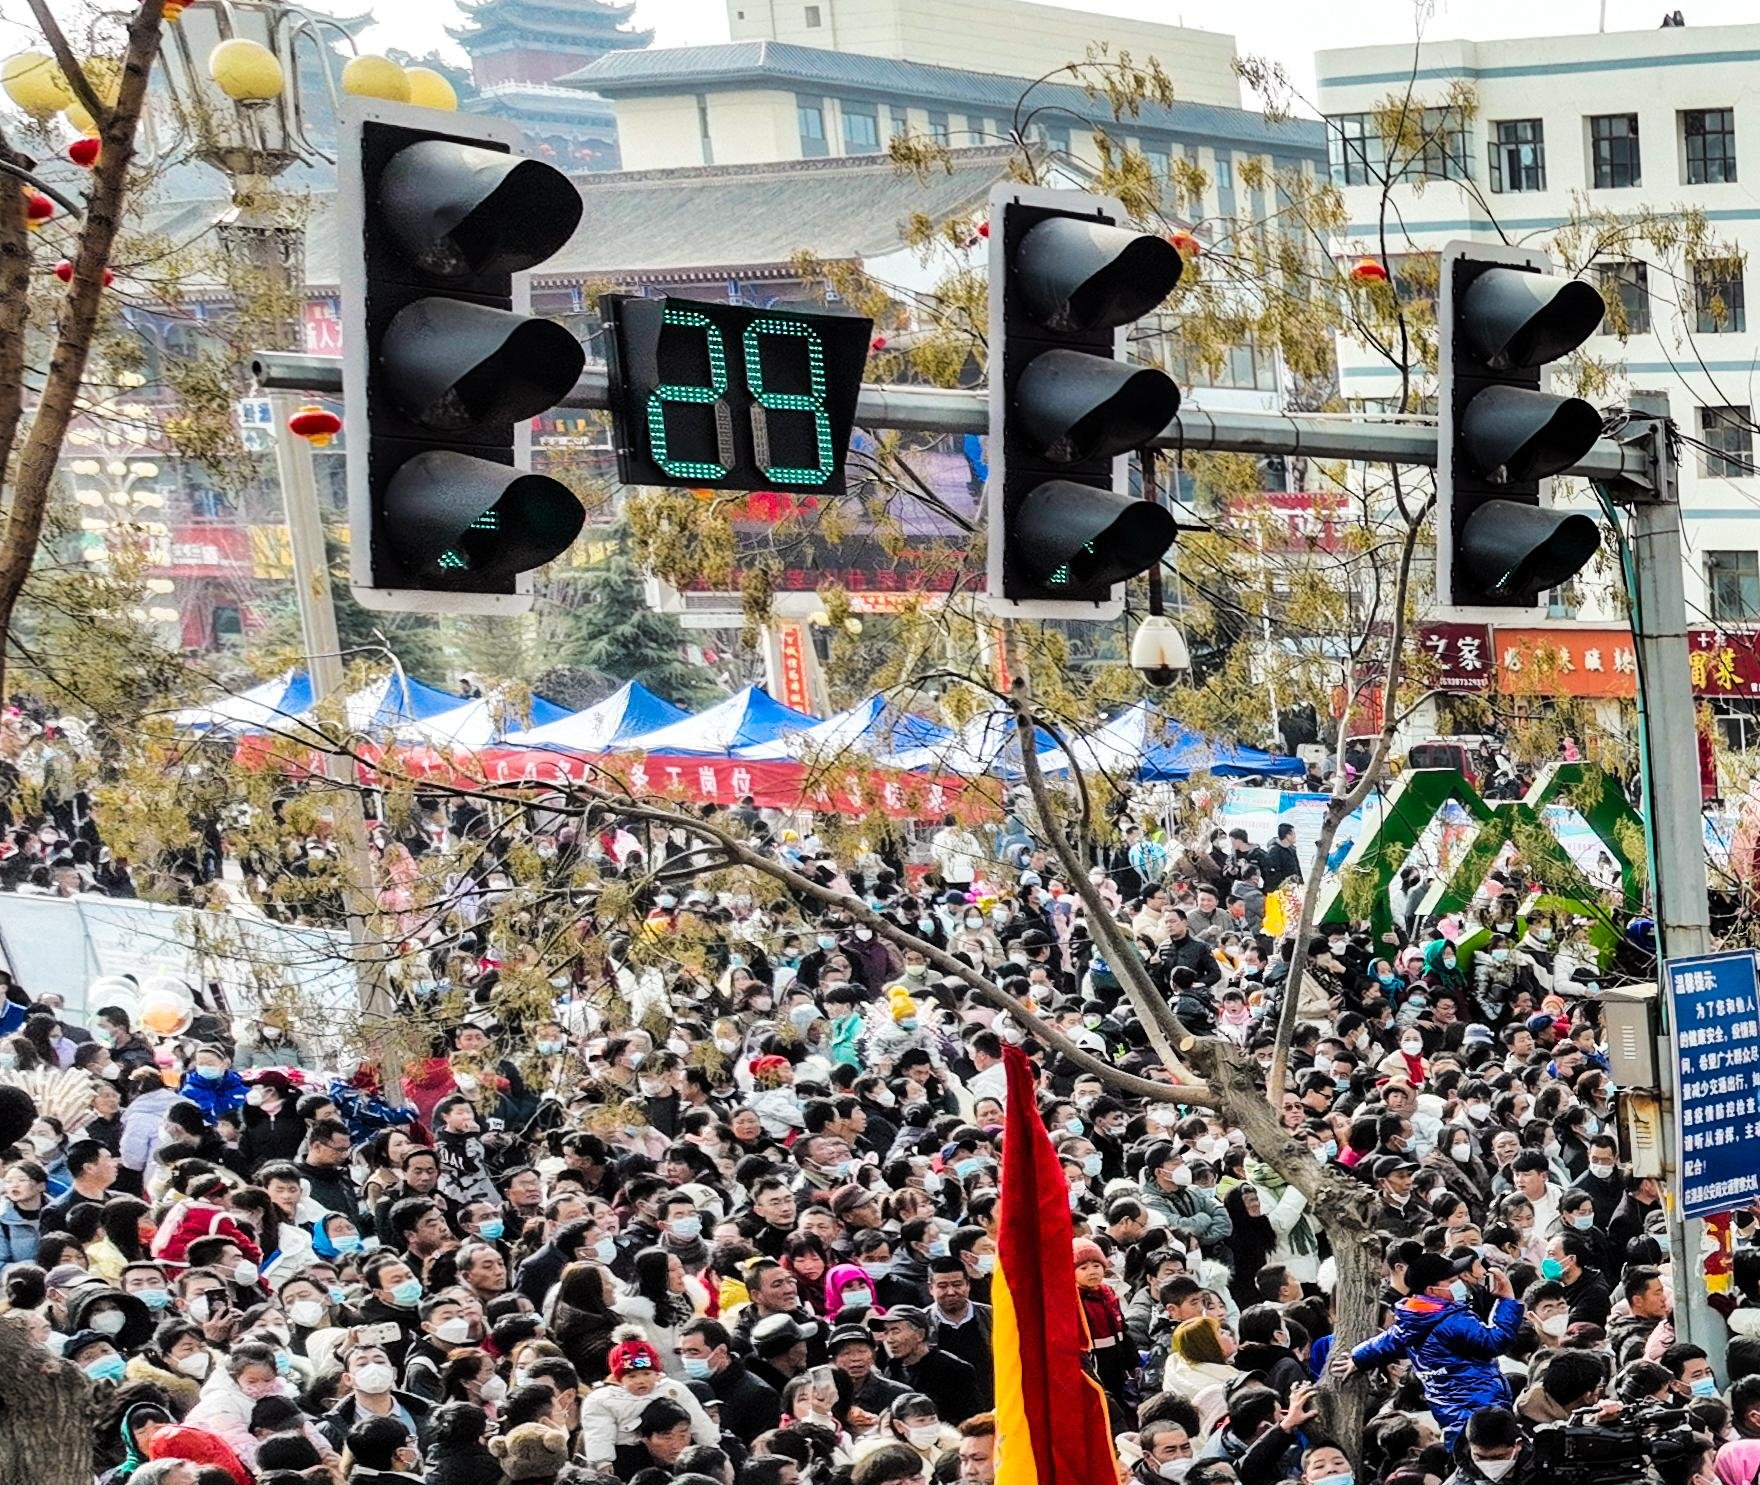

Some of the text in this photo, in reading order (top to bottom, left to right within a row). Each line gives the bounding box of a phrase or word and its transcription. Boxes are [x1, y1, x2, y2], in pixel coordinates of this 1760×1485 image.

[646, 307, 835, 486] 29
[1696, 995, 1755, 1020] 为了您和他人
